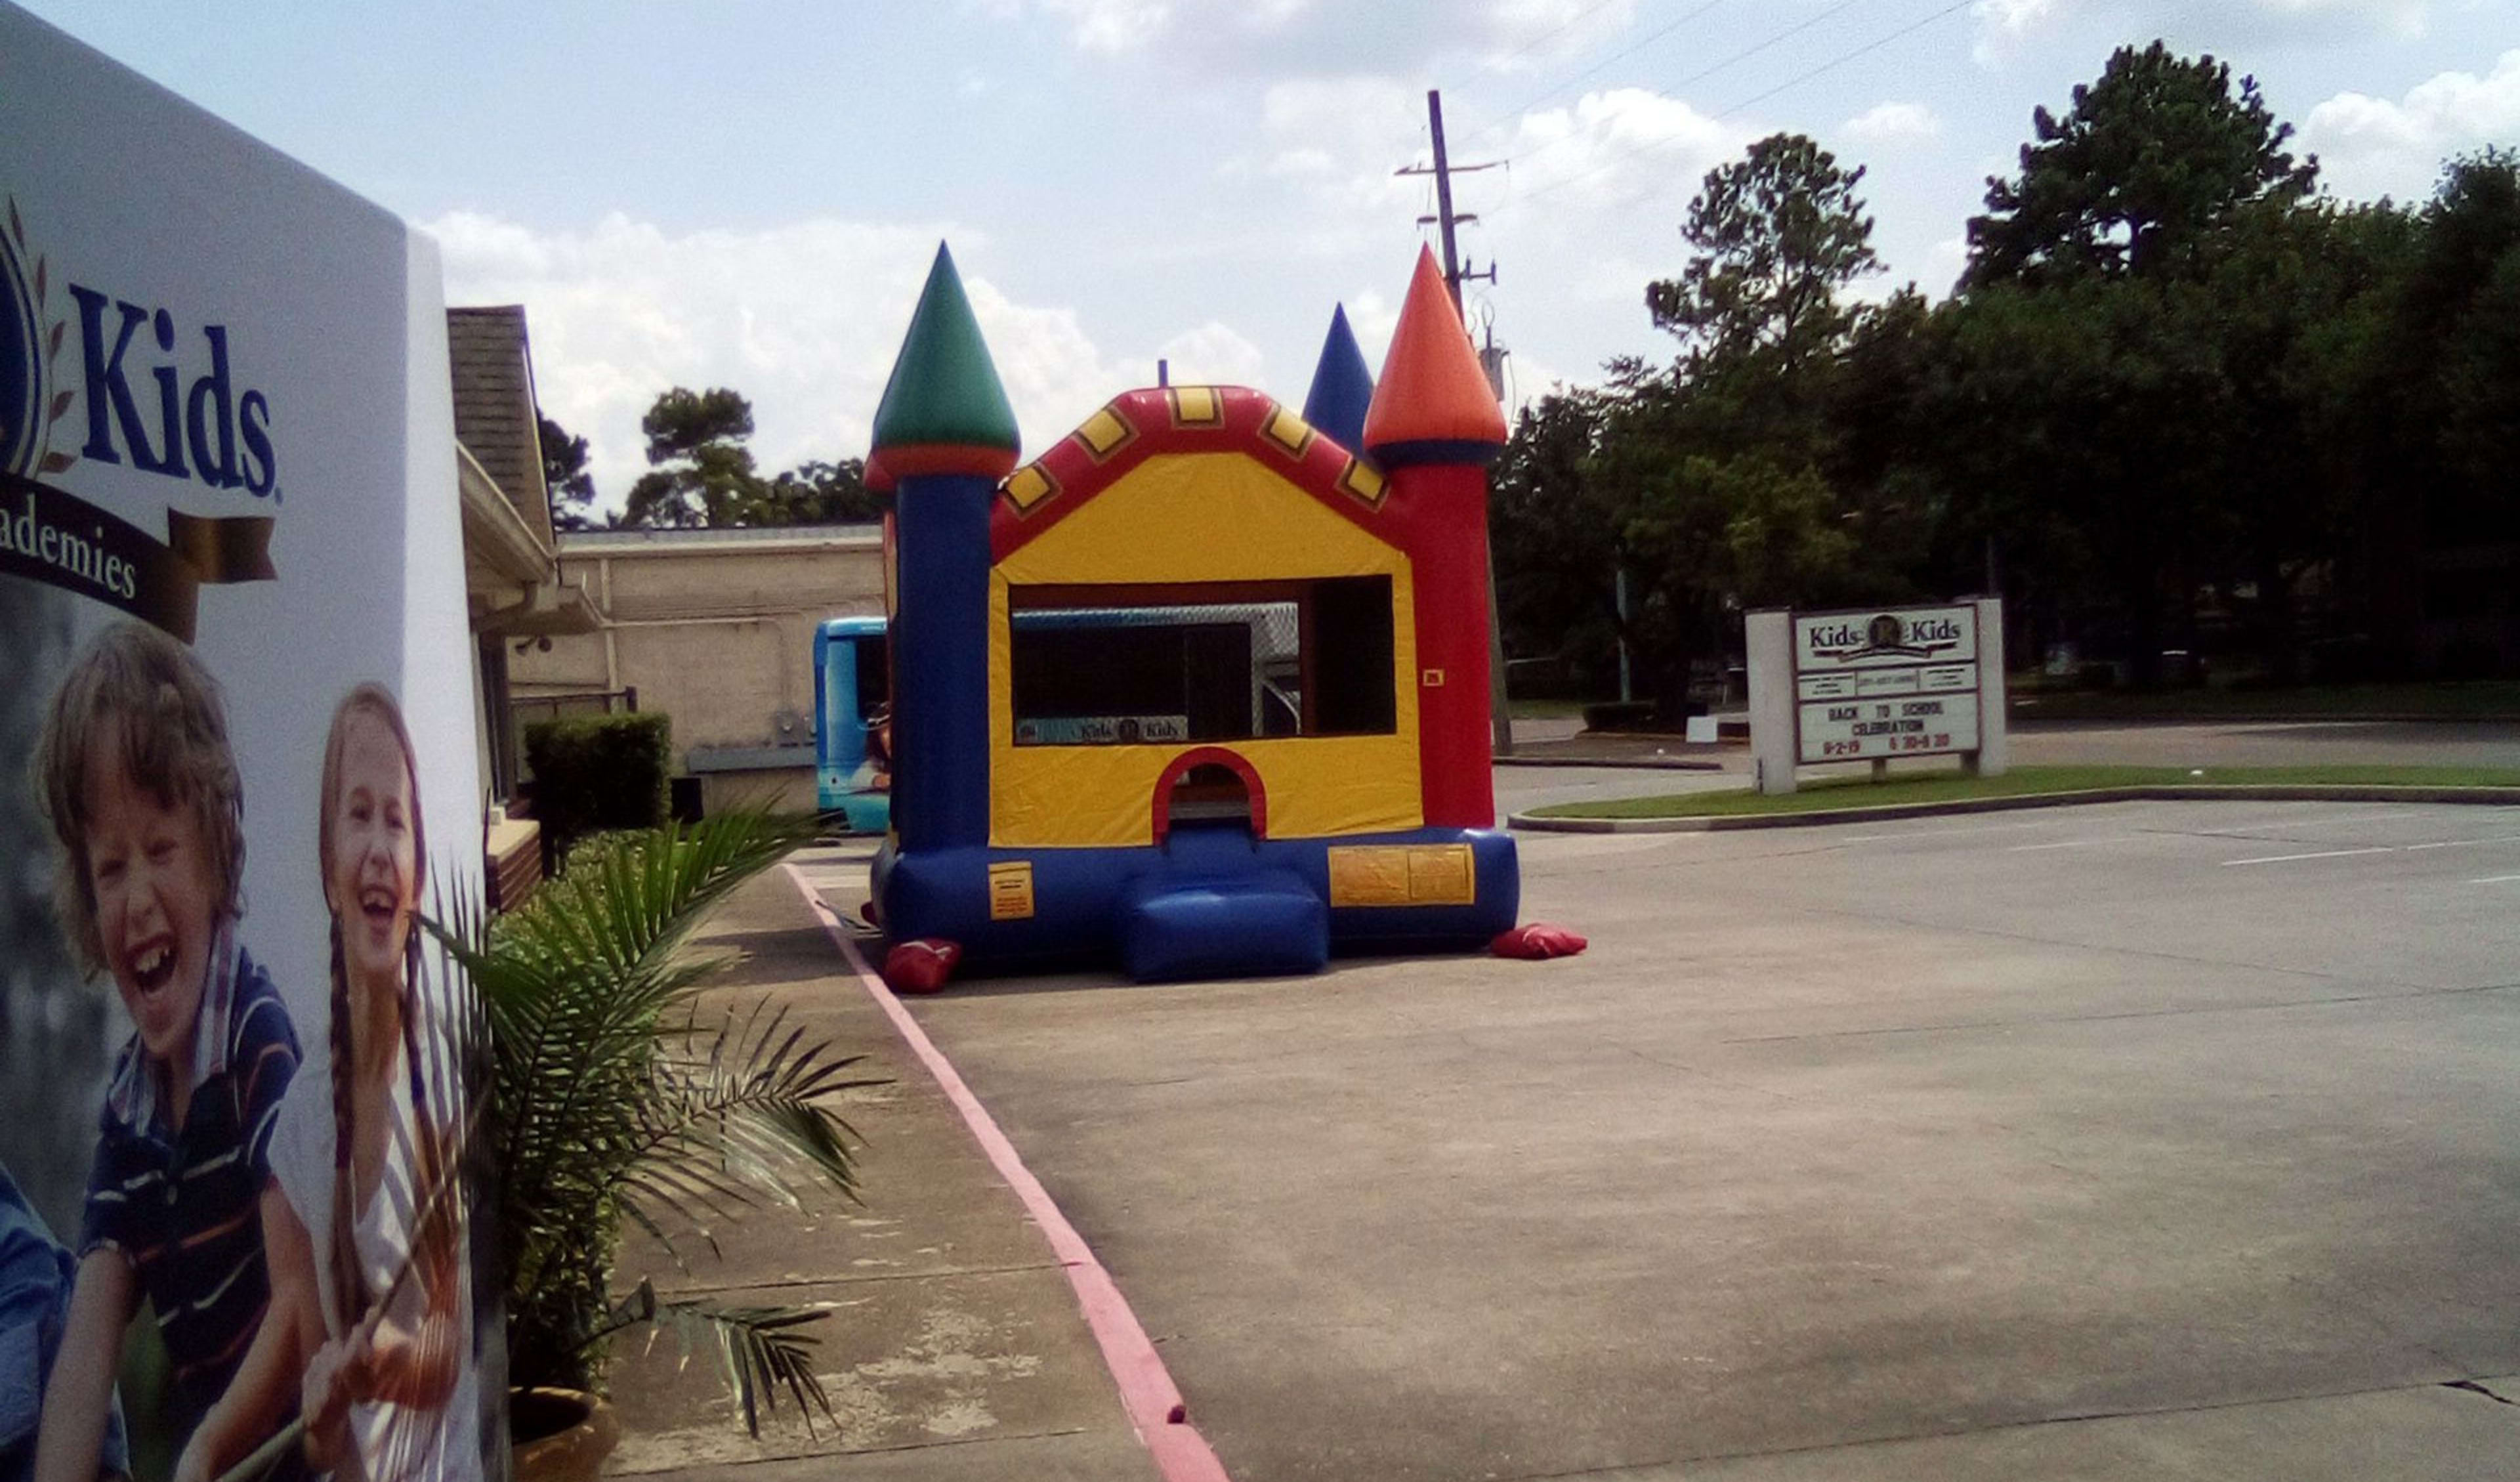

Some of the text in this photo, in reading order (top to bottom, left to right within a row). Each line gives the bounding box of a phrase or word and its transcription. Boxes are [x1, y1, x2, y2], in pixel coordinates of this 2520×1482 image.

[69, 283, 276, 498] Kids
[1810, 620, 1960, 647] Kids Kids
[1853, 720, 1923, 736] CELEBRATION
